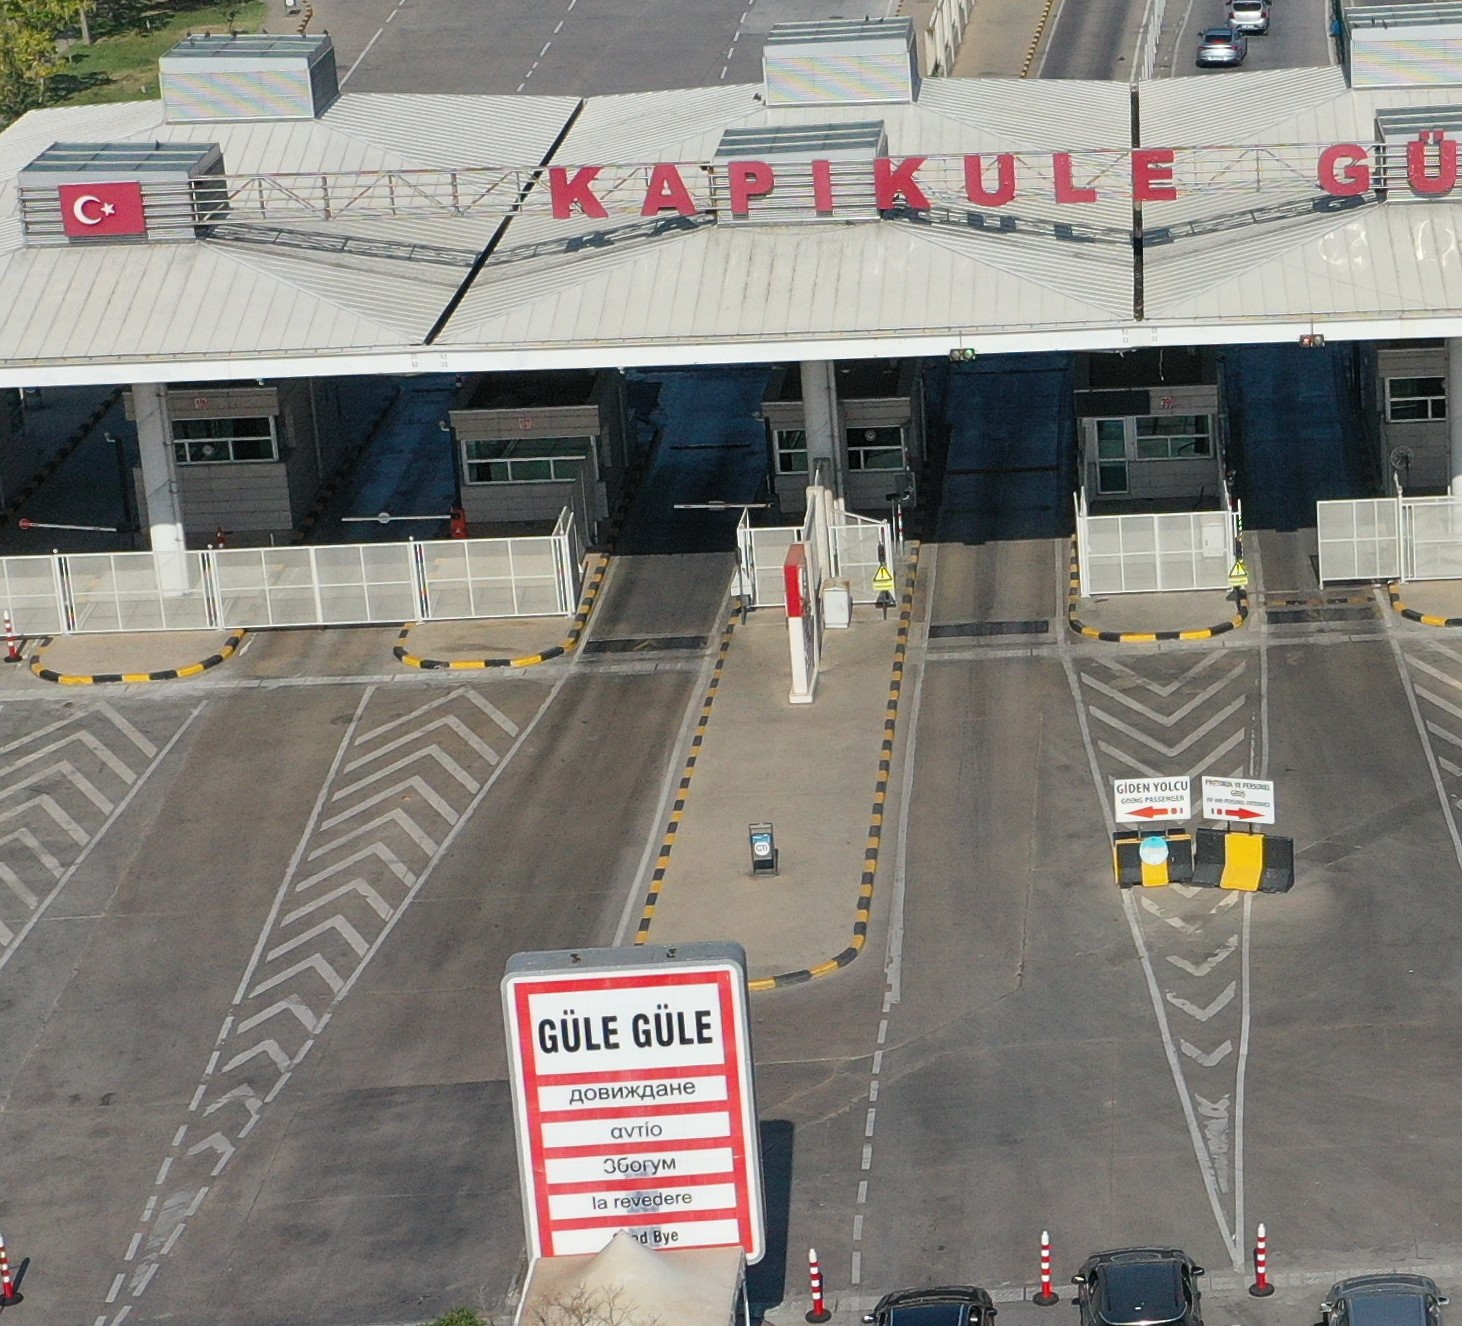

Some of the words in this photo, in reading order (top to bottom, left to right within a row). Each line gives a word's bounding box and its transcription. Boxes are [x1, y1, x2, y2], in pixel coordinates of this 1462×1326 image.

[549, 148, 1178, 219] KAPIKULE
[1116, 780, 1150, 794] GİDEN
[1153, 780, 1188, 793] YOLCU
[538, 1009, 620, 1054] GÜLE
[632, 1003, 713, 1048] GÜLE
[569, 1081, 696, 1105] довиждане
[611, 1121, 662, 1139] αντίο
[603, 1157, 676, 1175] Збогум
[592, 1196, 608, 1210] la
[614, 1191, 693, 1209] revedere
[653, 1229, 679, 1246] Bye
